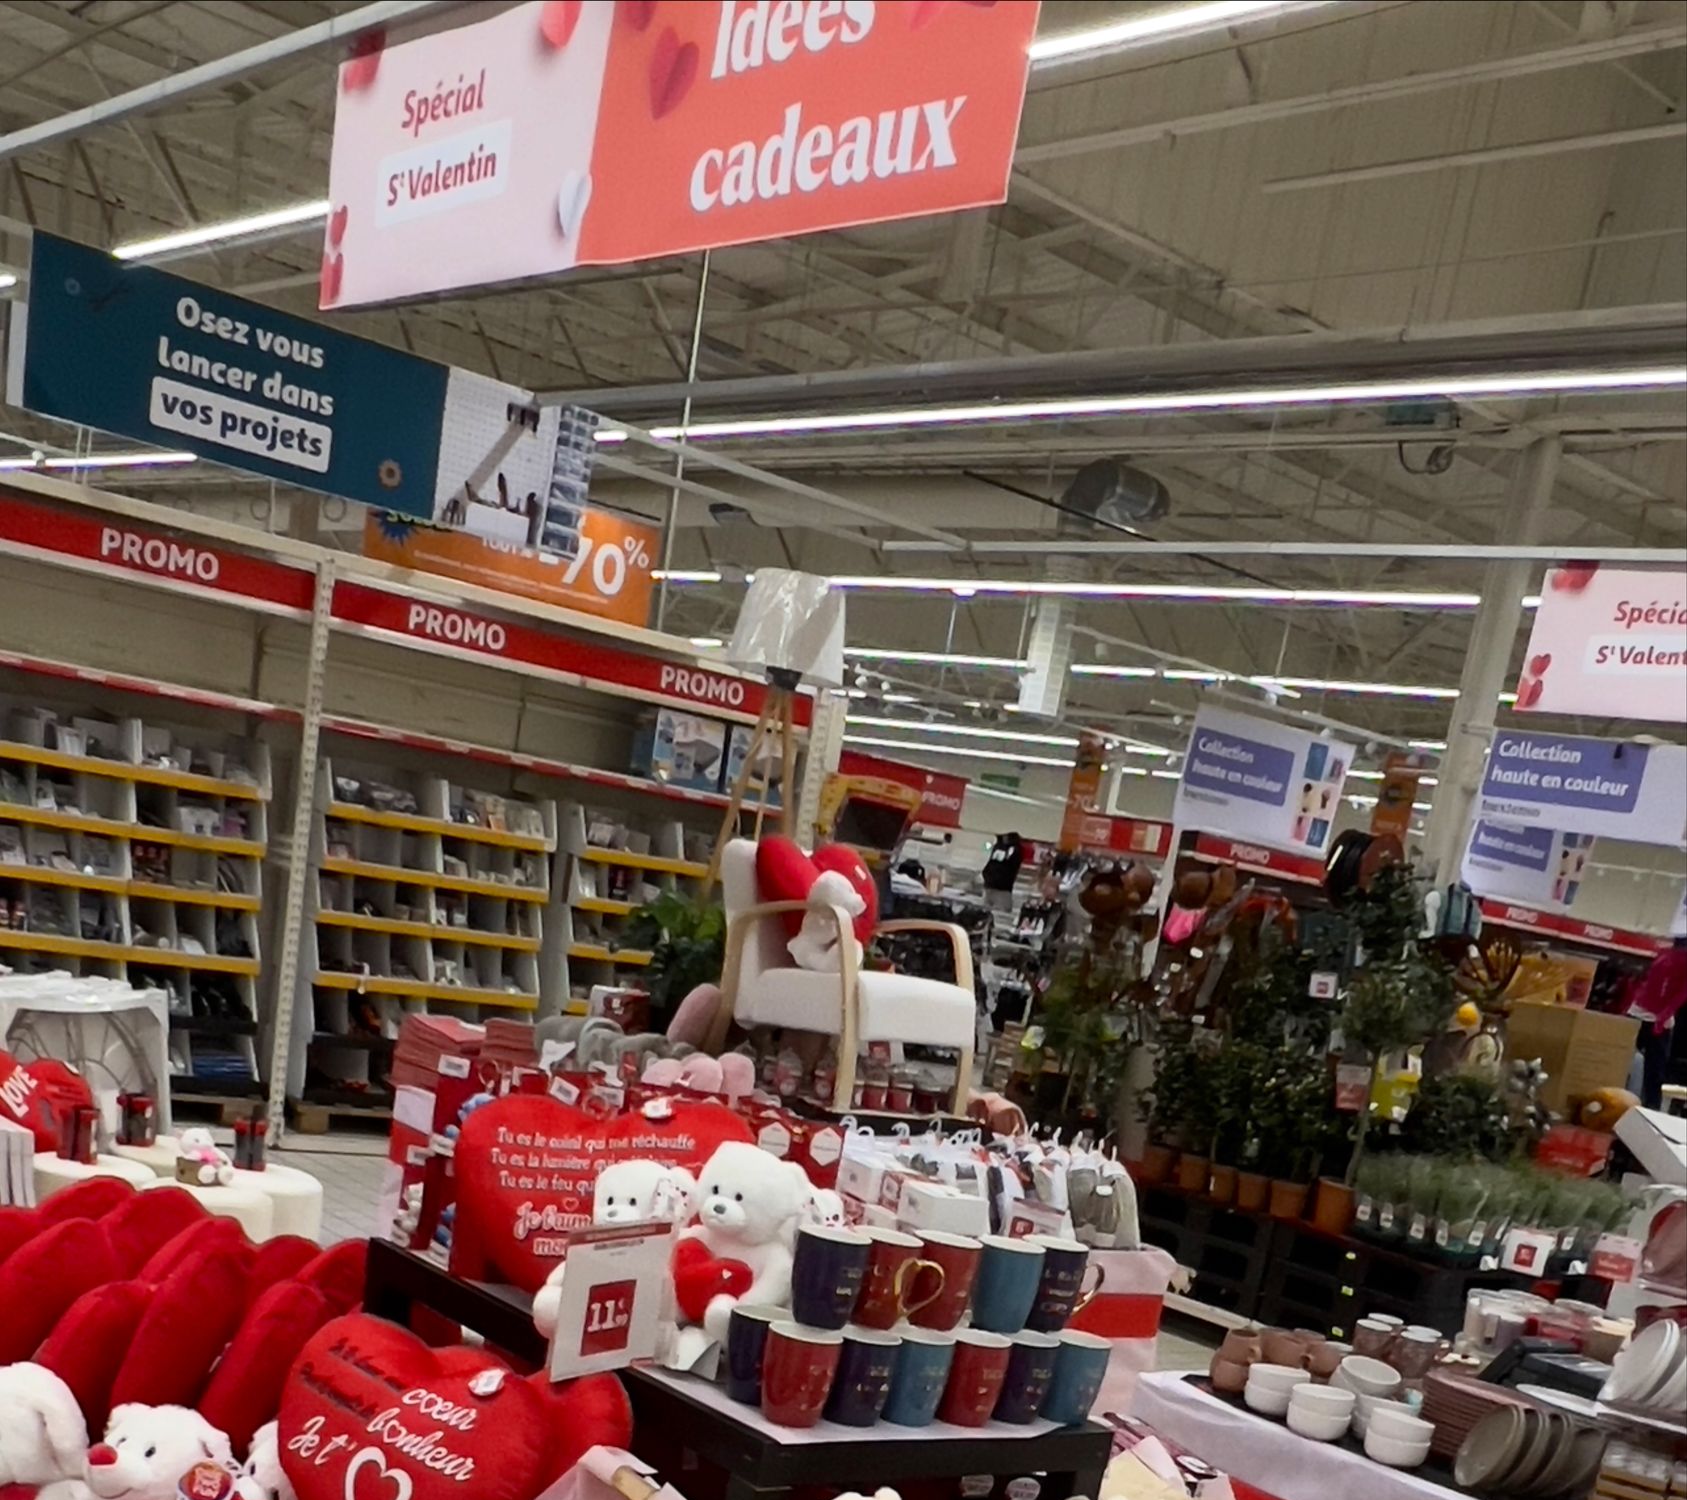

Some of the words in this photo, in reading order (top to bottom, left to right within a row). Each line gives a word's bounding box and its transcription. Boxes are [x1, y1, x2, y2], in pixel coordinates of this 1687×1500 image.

[401, 68, 486, 138] Spécial
[408, 143, 497, 200] Valentin
[689, 95, 968, 213] cadeaux
[176, 296, 249, 345] Osez
[256, 328, 324, 369] vous
[262, 370, 335, 416] dans
[161, 392, 213, 426] vos
[219, 410, 323, 458] projets
[101, 527, 220, 582] PROMO
[408, 604, 506, 651] PROMO
[1613, 600, 1687, 629] Spécia
[1619, 645, 1687, 665] Valent
[661, 665, 744, 706] PROMO
[1499, 739, 1582, 764] Collection
[1490, 765, 1539, 788] haute
[1541, 774, 1561, 789] en
[1564, 776, 1629, 797] couleur
[0, 1064, 39, 1118] LOVE
